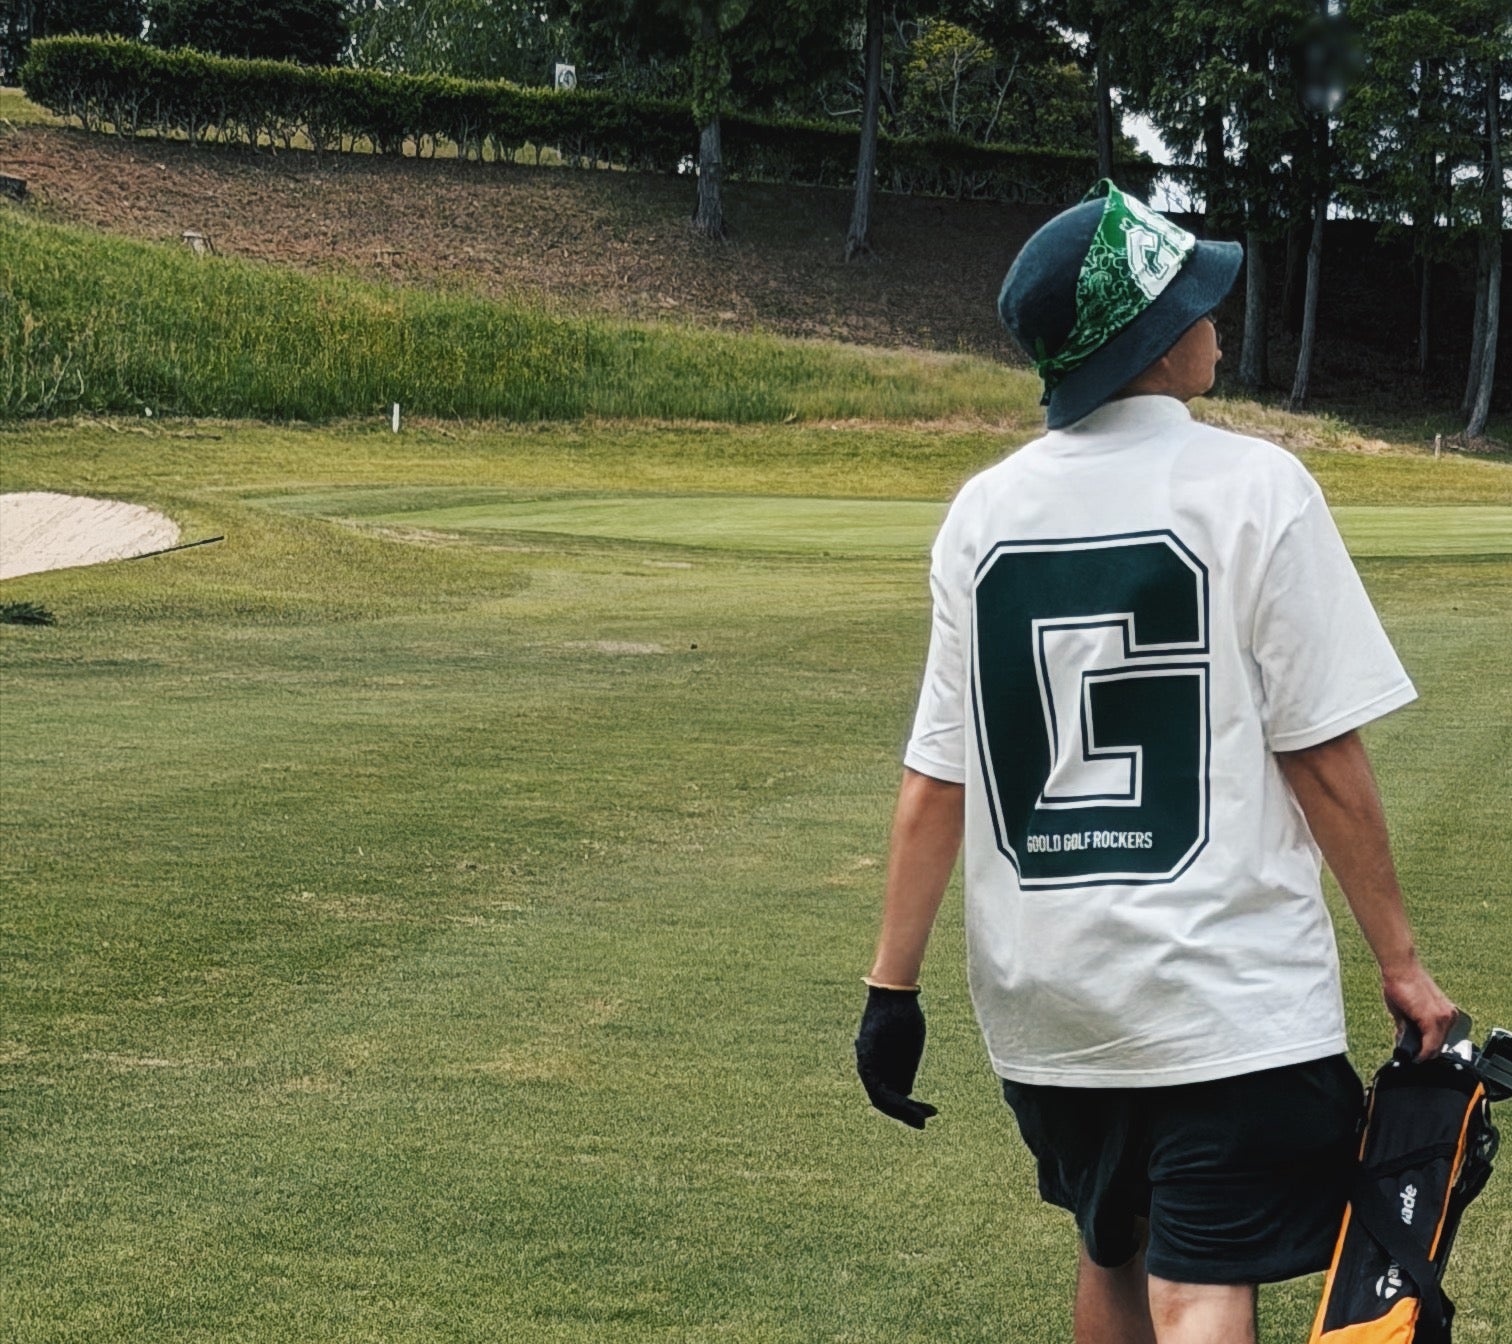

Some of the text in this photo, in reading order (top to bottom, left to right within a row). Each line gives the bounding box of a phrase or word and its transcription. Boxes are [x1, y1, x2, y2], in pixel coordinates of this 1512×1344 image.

[968, 529, 1211, 892] G
[1027, 830, 1153, 853] GOOLD GOLF ROCKERS
